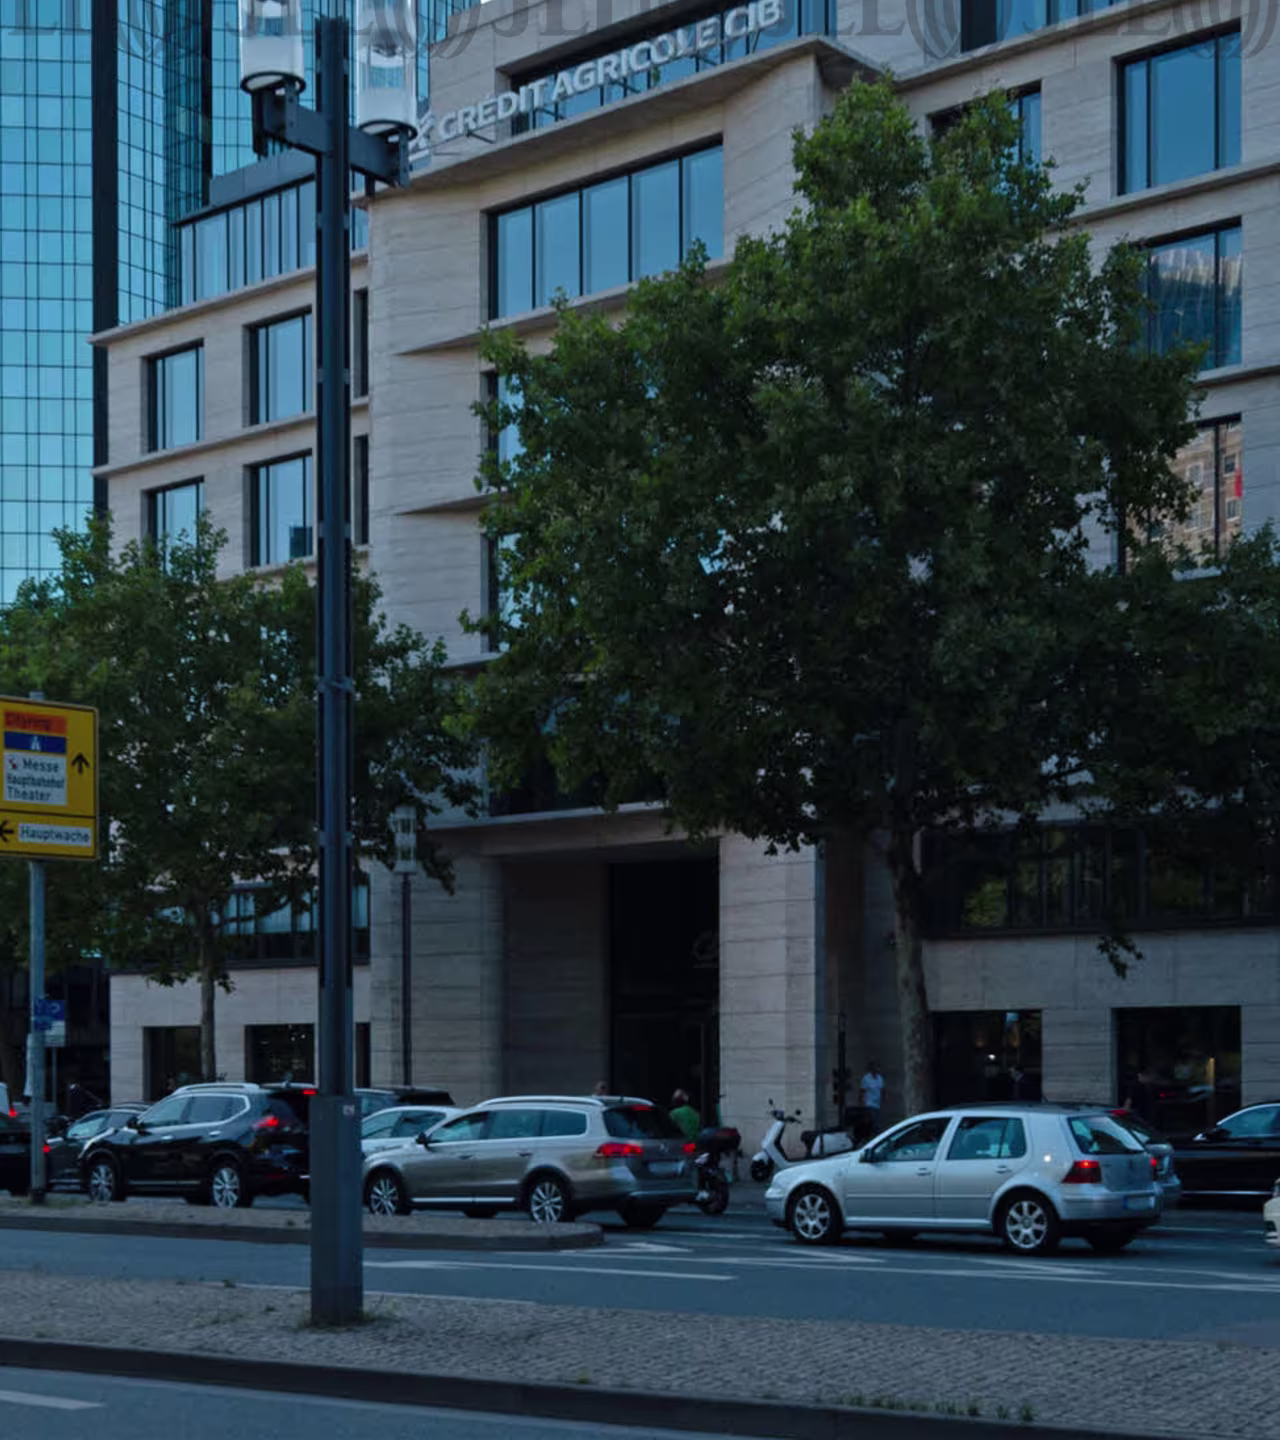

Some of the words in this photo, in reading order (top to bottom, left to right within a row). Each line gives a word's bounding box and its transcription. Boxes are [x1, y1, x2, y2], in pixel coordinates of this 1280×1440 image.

[552, 18, 720, 101] AGRICOLE
[23, 759, 59, 773] Messe
[7, 787, 52, 801] Theater
[20, 825, 90, 842] Hauptwache
